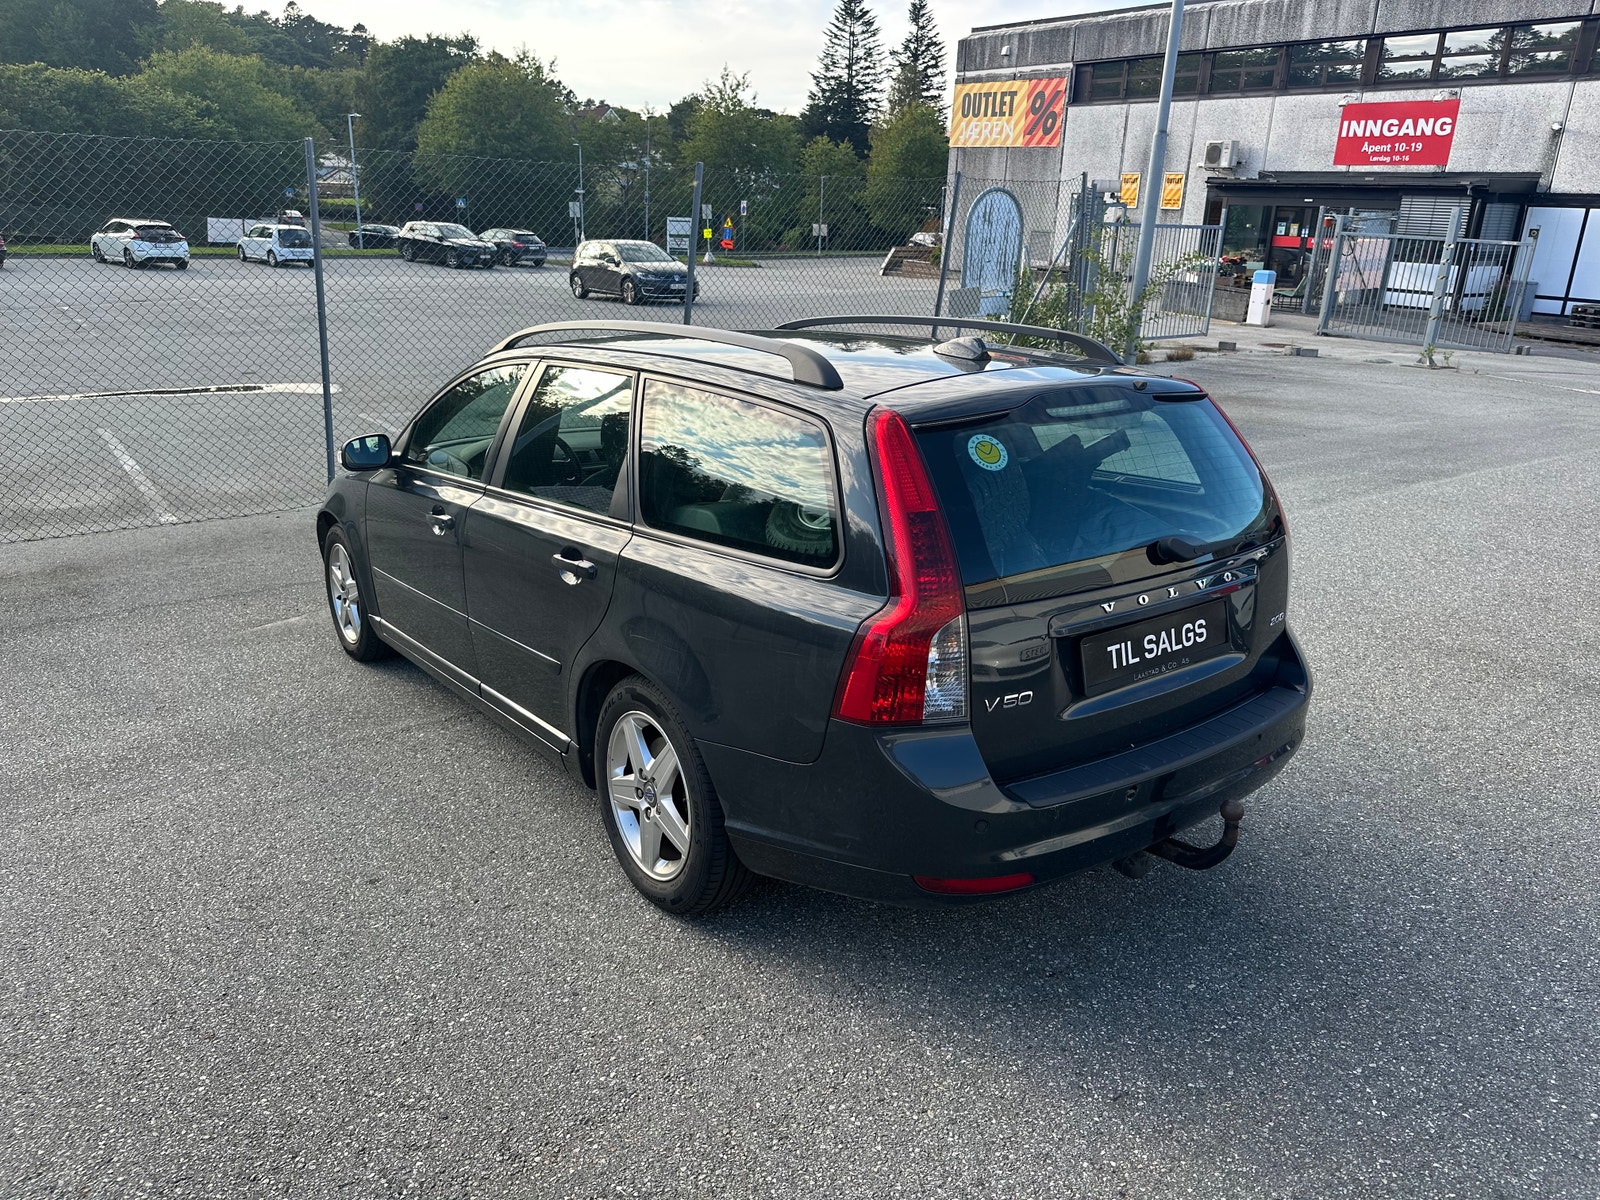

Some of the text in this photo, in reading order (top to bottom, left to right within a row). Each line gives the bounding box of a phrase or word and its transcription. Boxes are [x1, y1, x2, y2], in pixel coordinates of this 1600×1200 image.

[961, 90, 1018, 119] OUTLET
[1026, 90, 1063, 137] %
[958, 121, 1015, 143] JÆREN
[1340, 117, 1452, 138] INNGANG
[1361, 142, 1423, 154] Åpent 10-19
[1100, 571, 1232, 615] VOLVO
[1107, 619, 1208, 670] TIL SALGS
